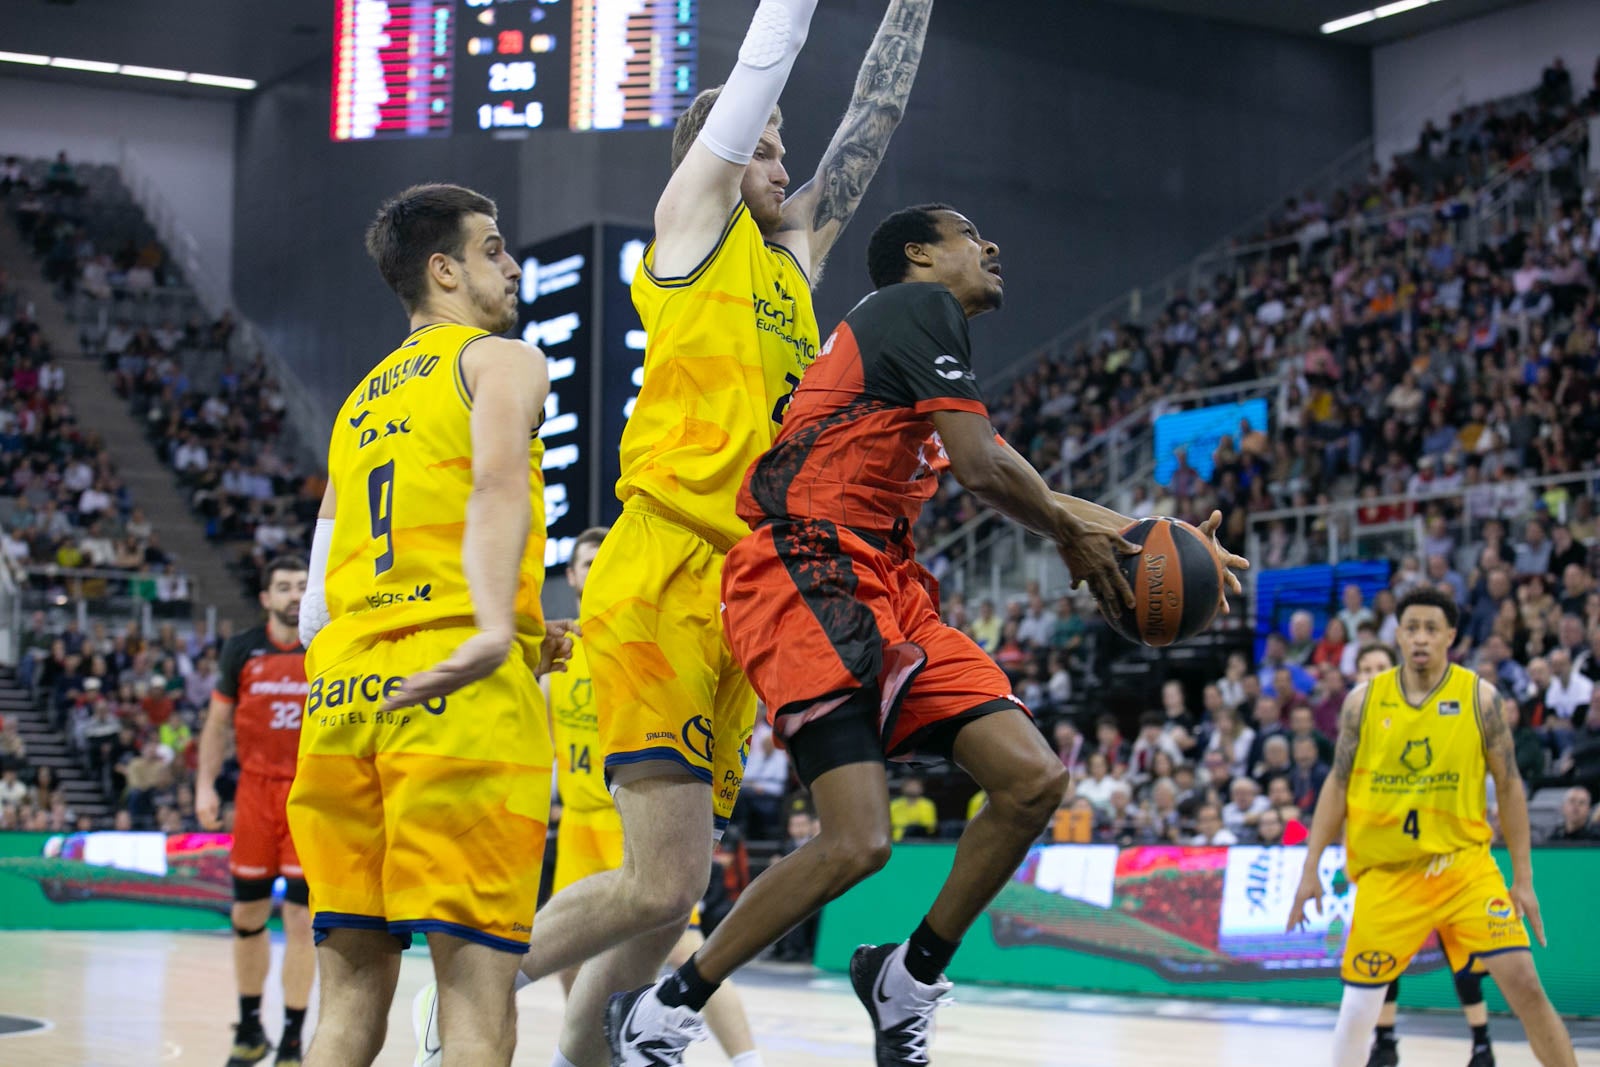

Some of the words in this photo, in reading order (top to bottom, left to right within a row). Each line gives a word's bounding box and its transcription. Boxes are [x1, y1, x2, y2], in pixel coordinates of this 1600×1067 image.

[368, 458, 395, 577] 9
[270, 702, 302, 730] 32
[569, 743, 591, 775] 14
[1403, 808, 1420, 840] 4
